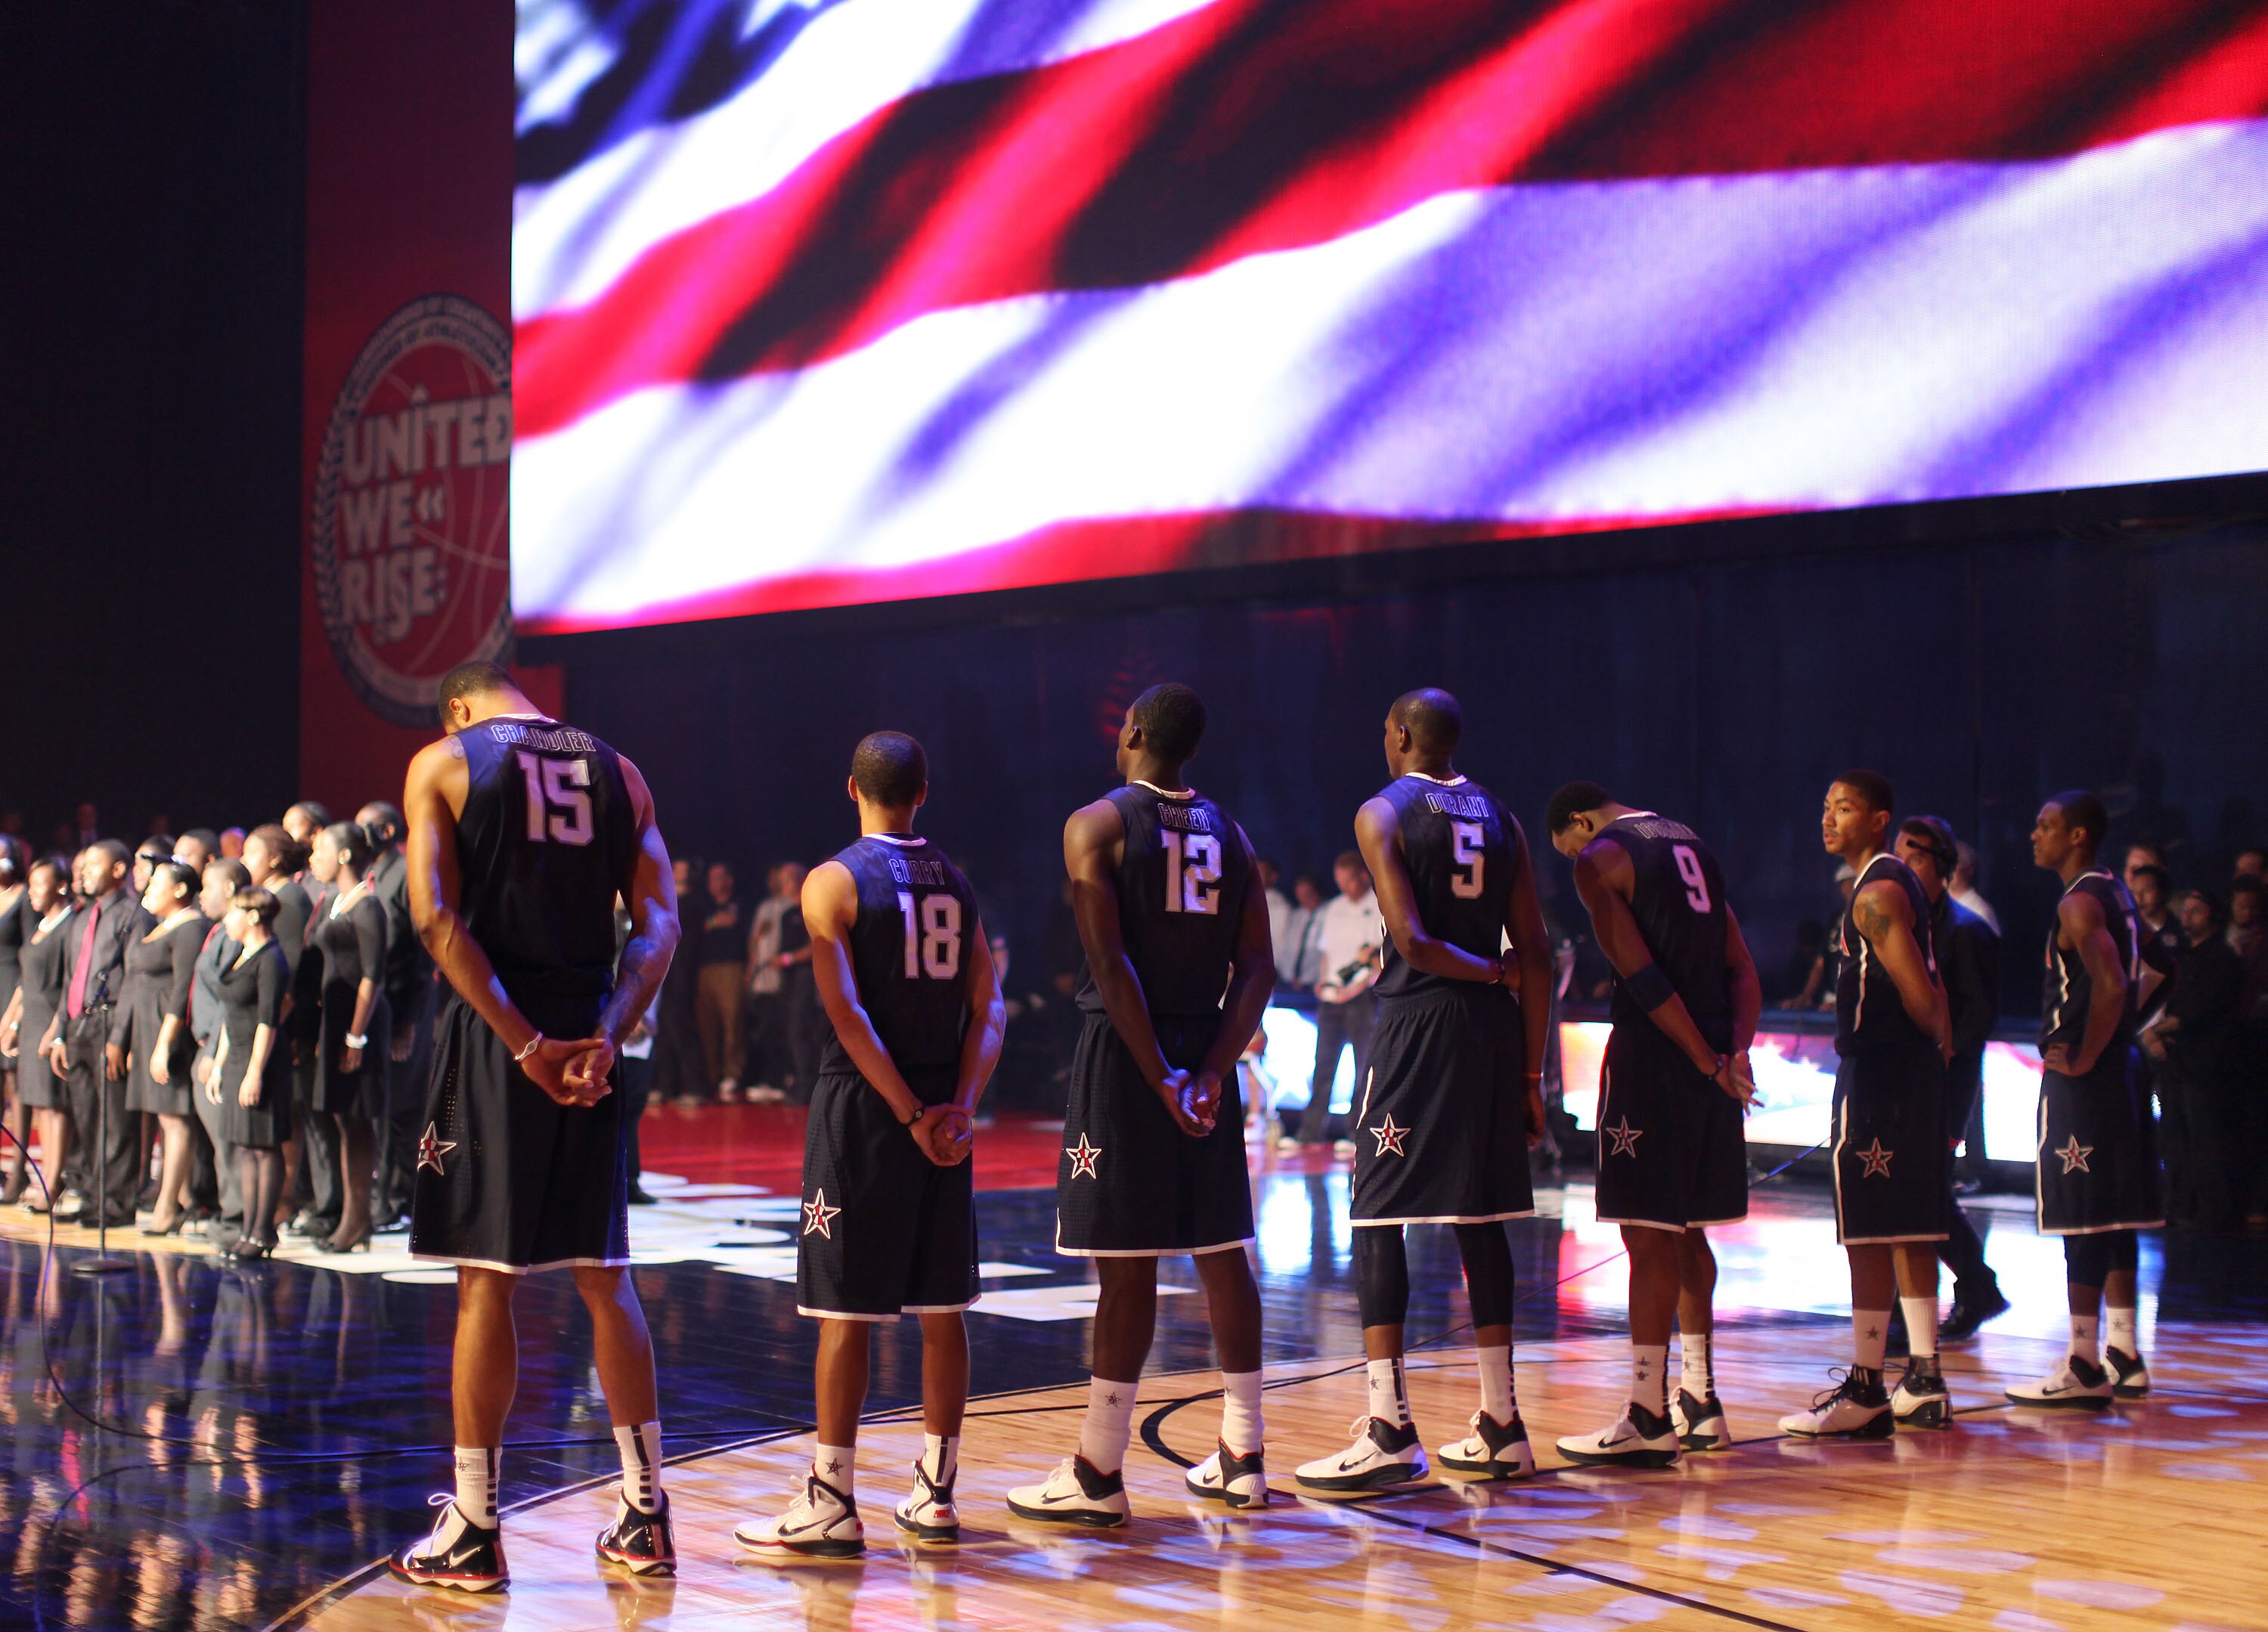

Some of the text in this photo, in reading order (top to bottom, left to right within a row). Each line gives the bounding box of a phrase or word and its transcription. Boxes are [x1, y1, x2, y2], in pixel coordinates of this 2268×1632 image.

[342, 386, 511, 487] UNITED
[340, 479, 414, 555] WE
[491, 724, 596, 752] CHANDLER
[516, 750, 595, 847] 15
[1157, 802, 1210, 831] GREEN
[1425, 793, 1489, 817] DURANT
[889, 859, 945, 884] CURRY
[1160, 829, 1222, 915] 12
[1450, 821, 1485, 900] 5
[1672, 844, 1712, 914] 9
[897, 891, 962, 980] 18
